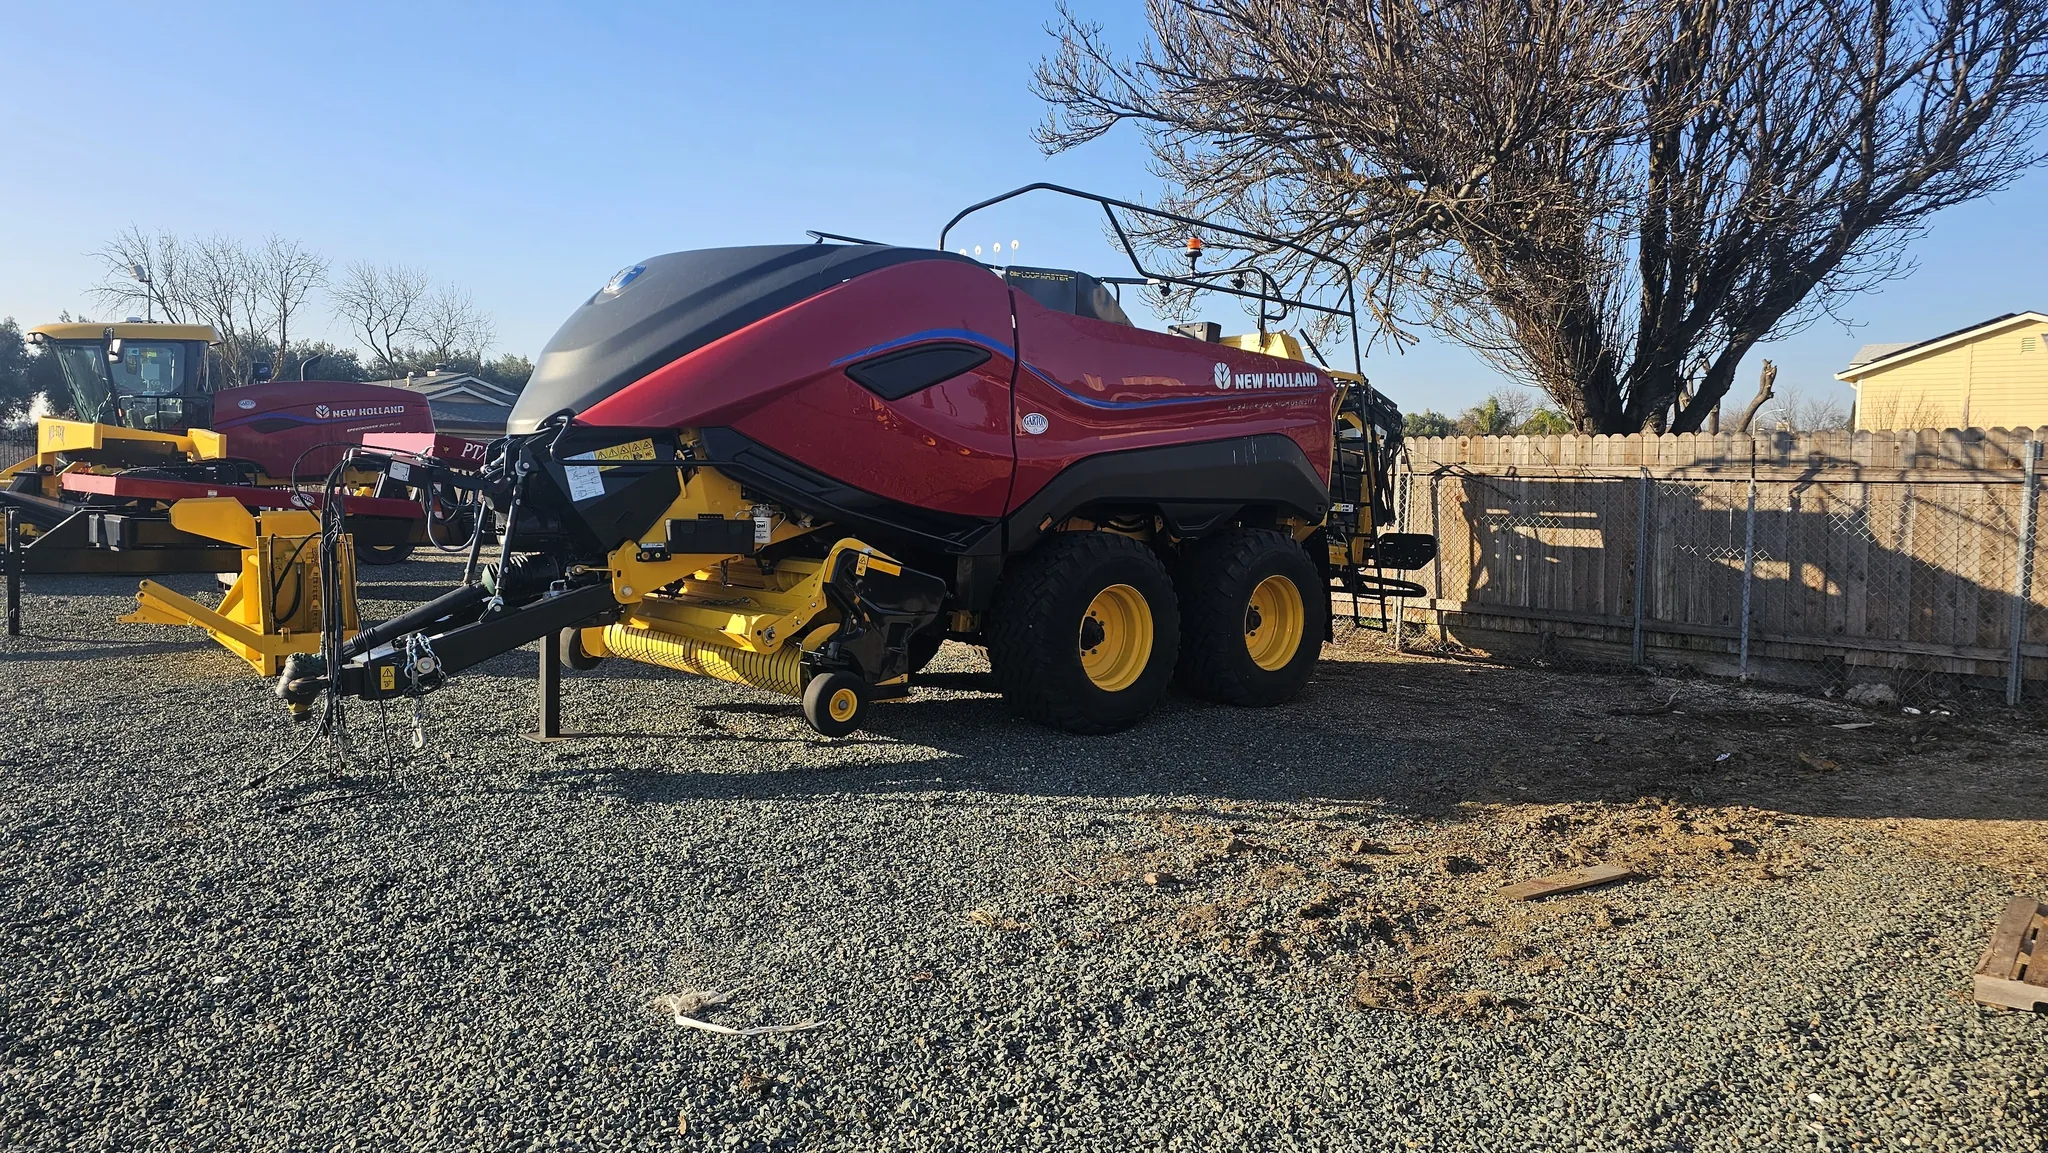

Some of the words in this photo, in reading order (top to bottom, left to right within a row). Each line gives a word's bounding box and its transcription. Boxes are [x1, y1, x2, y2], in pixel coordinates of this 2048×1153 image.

[1235, 373, 1263, 390] NEW
[1266, 372, 1318, 388] HOLLAND
[332, 409, 356, 418] NEW
[359, 405, 405, 417] HOLLAND
